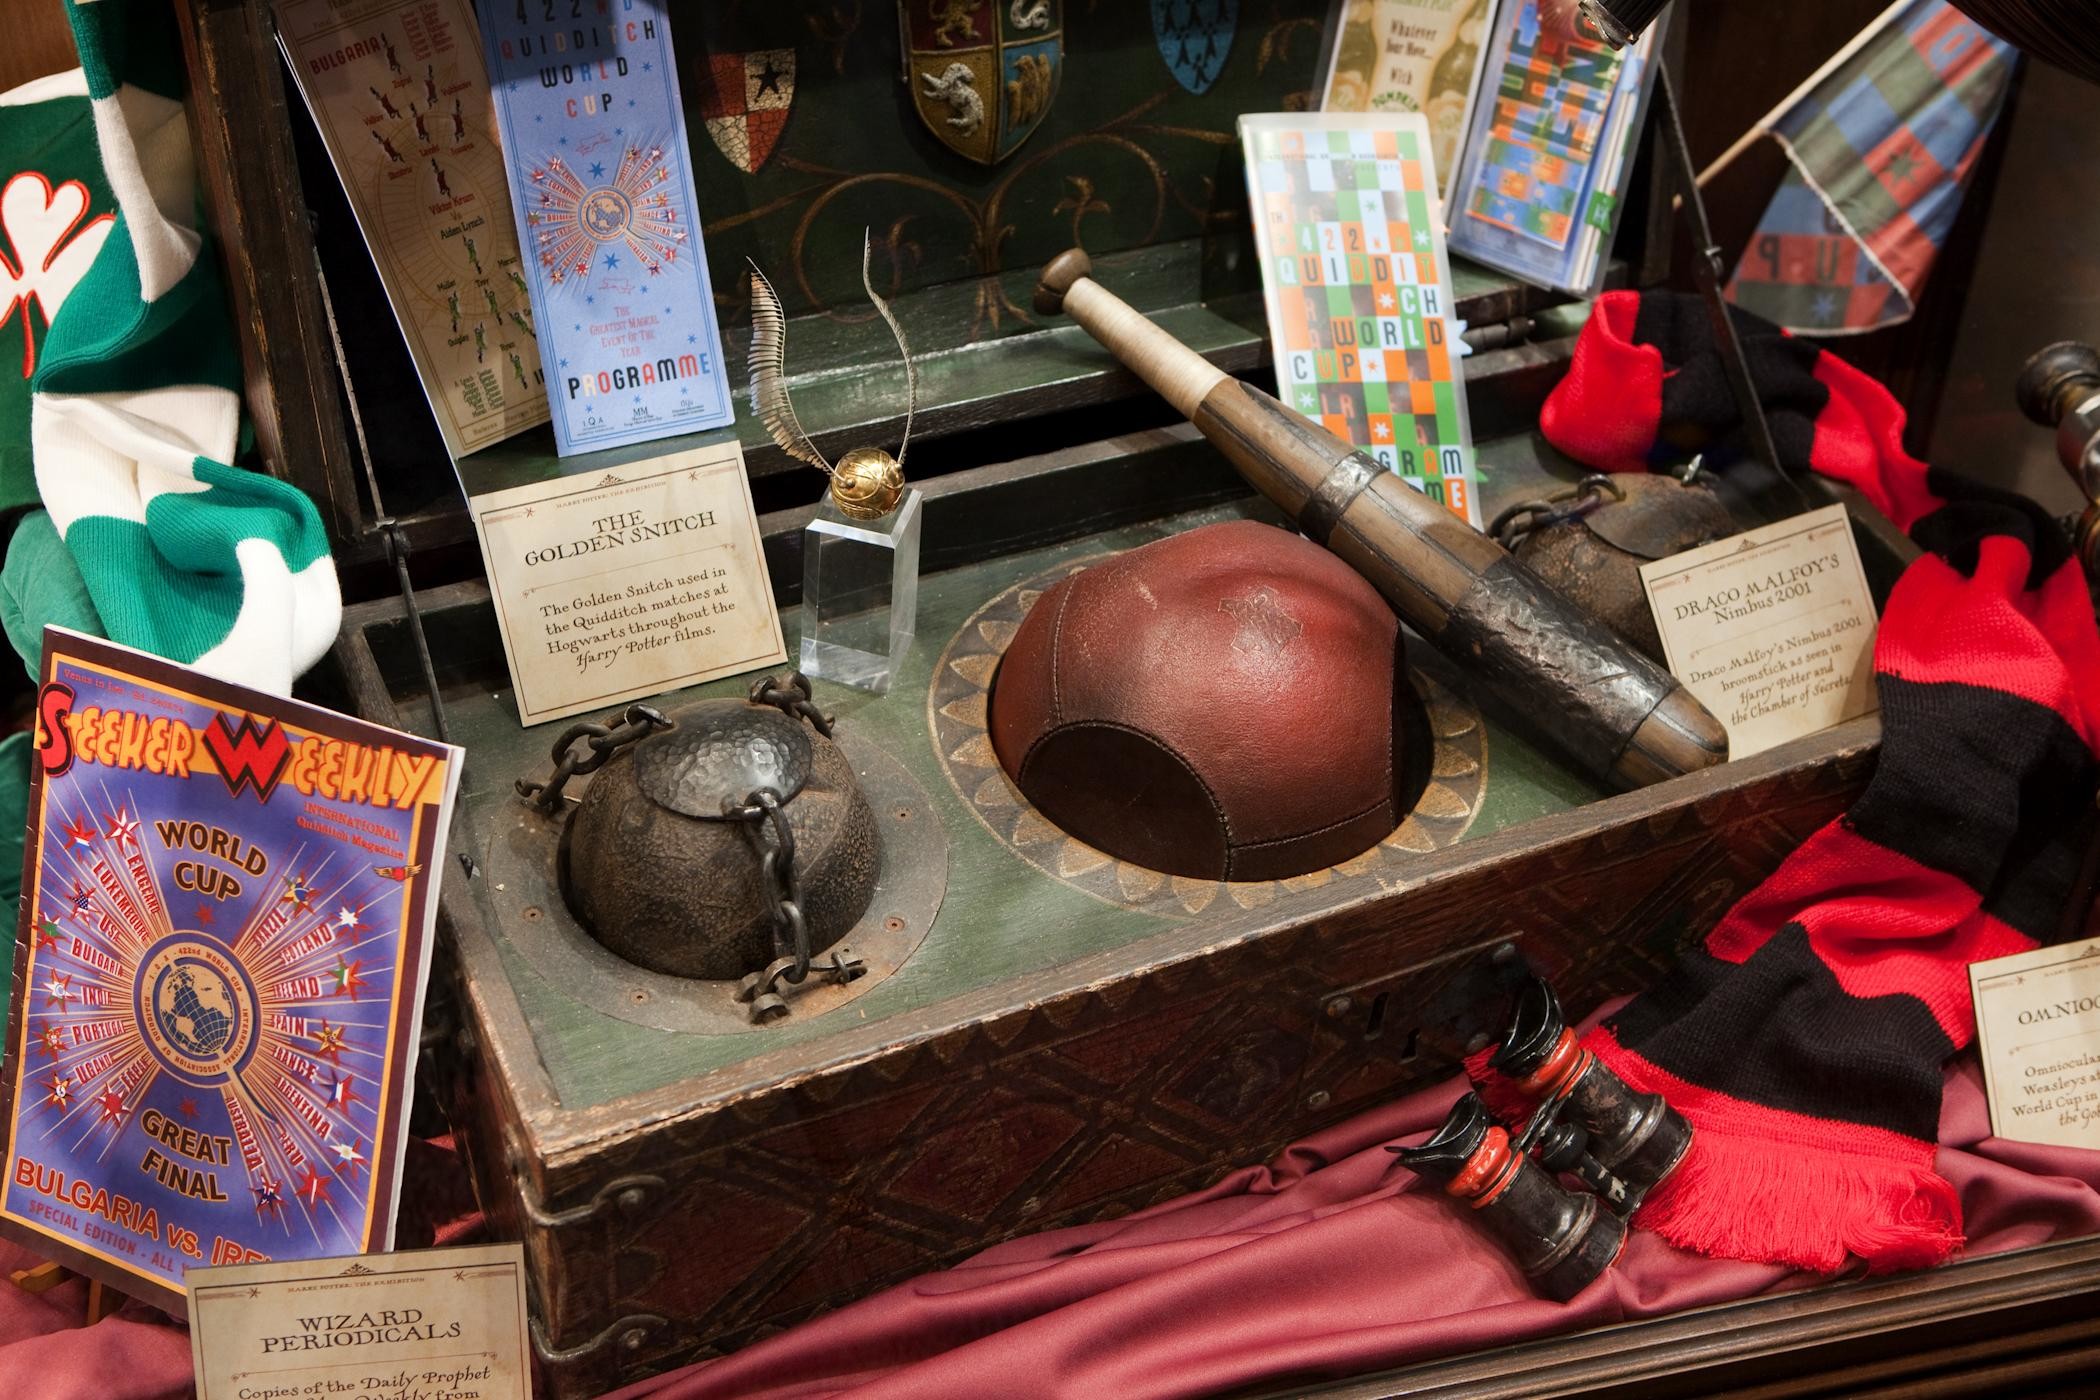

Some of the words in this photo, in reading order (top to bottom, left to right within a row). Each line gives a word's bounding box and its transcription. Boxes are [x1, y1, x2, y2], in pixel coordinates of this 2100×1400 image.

[309, 36, 382, 75] BULGARIA
[501, 20, 656, 60] QUIDDITCH
[540, 57, 629, 88] WORLD
[565, 93, 612, 118] CUP
[1332, 316, 1443, 346] WORLD
[568, 352, 711, 400] PROGRAMME
[1293, 353, 1356, 380] CUP
[525, 531, 625, 566] GOLDEN
[630, 511, 718, 543] SNITCH
[592, 510, 645, 533] THE
[540, 603, 570, 618] The
[572, 591, 622, 611] Golden
[626, 578, 673, 598] Snitch
[677, 570, 709, 585] used
[711, 565, 727, 578] in
[1674, 587, 1741, 621] DRACO
[1745, 553, 1841, 597] MALFOY'S
[1714, 594, 1775, 625] Nimbus
[1775, 581, 1812, 603] 2001
[545, 620, 570, 635] the
[573, 602, 648, 630] Quidditch
[651, 589, 711, 611] matches
[713, 583, 729, 596] at
[547, 626, 626, 655] Hogwarts
[629, 605, 710, 635] throughout
[712, 600, 736, 615] the
[575, 646, 622, 674] Harry
[624, 634, 672, 653] Potter
[674, 626, 716, 643] films.
[1689, 664, 1728, 684] Draco
[1728, 642, 1785, 672] Malfoy's
[1786, 627, 1832, 653] Nimbus
[1833, 615, 1863, 634] 2001
[1721, 656, 1789, 692] broomstick
[1789, 653, 1804, 667] as
[1805, 646, 1829, 662] seen
[1830, 643, 1842, 655] in
[1739, 683, 1776, 711] Harry
[1777, 670, 1813, 690] Potter
[1814, 658, 1834, 677] and
[1731, 709, 1749, 726] the
[1750, 693, 1798, 719] Chamber
[1799, 686, 1811, 708] of
[38, 681, 195, 780] SEEKER
[201, 710, 438, 812] WEEKLY
[303, 802, 400, 843] INTERNATIONAL
[156, 819, 268, 878] WORLD
[93, 859, 151, 942] LUXEMBOURG
[173, 861, 241, 902] CUP
[98, 914, 121, 943] USA
[279, 923, 335, 966] SCOTLAND
[71, 937, 125, 977] BULGARIA
[273, 976, 321, 998] IRELAND
[71, 1020, 126, 1046] PORTUGAL
[271, 1014, 308, 1037] SPAIN
[273, 1046, 320, 1084] FRANCE
[2012, 1099, 2053, 1117] World
[2056, 1093, 2082, 1112] Cup
[2085, 1091, 2098, 1101] in
[2023, 1076, 2086, 1096] Weasleys
[273, 1076, 333, 1141] ARGENTINA
[2059, 1110, 2079, 1126] the
[140, 1107, 232, 1166] GREAT
[225, 1096, 266, 1172] AUSTRALIA
[278, 1126, 306, 1168] PERU
[141, 1148, 228, 1202] FINAL
[15, 1157, 160, 1241] BULGARIA
[28, 1200, 79, 1232] SPECIAL
[84, 1222, 137, 1257] EDITION
[151, 1252, 174, 1273] ALL
[260, 1321, 461, 1353] PERIODICALS
[296, 1308, 423, 1332] WIZARD
[238, 1385, 300, 1400] Copies
[304, 1381, 325, 1395] of
[327, 1377, 356, 1393] the
[360, 1371, 419, 1396] Daily
[422, 1364, 492, 1389] Prophet
[434, 1389, 480, 1400] from
